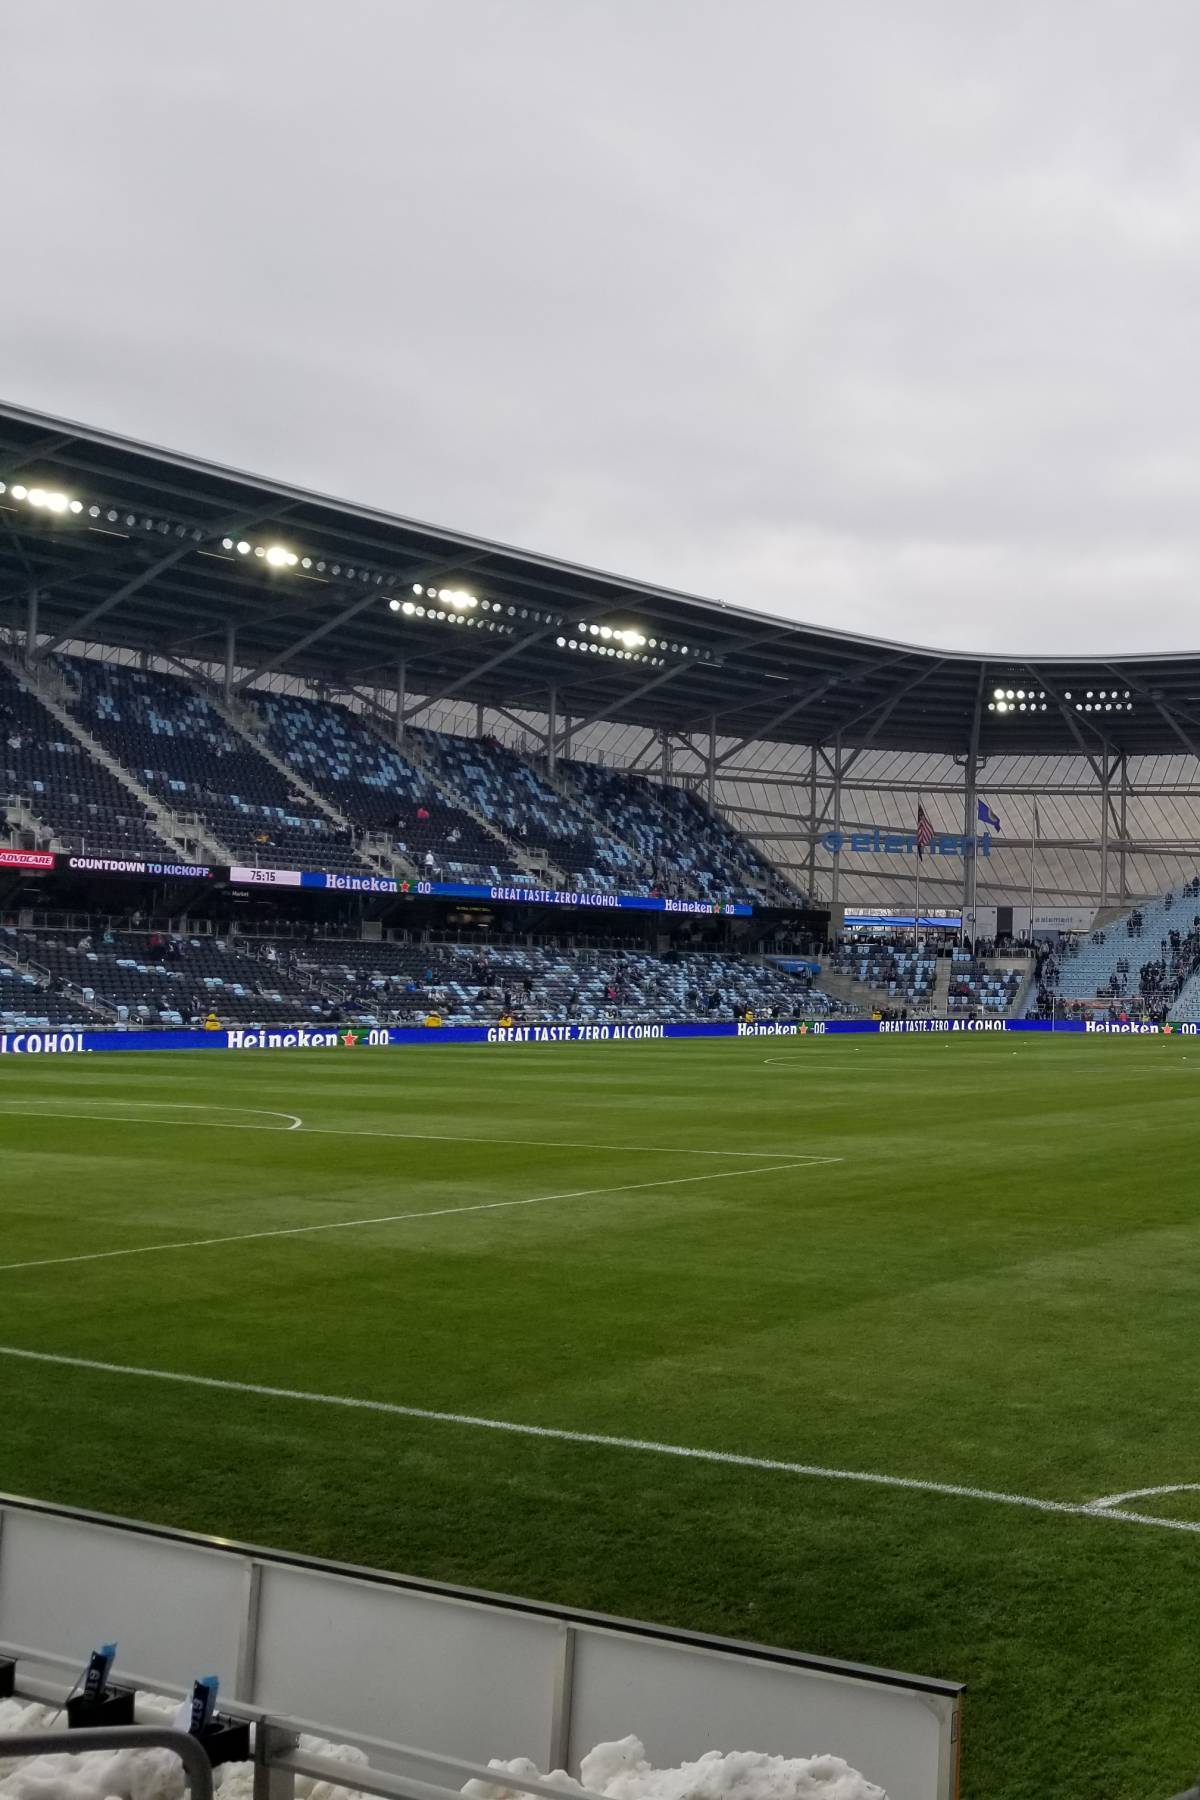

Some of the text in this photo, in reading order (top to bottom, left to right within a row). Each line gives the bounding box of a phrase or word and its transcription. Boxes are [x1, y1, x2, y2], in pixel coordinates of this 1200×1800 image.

[69, 857, 146, 873] COUNTDOWN
[146, 863, 162, 874] TO
[250, 870, 276, 882] 75:15
[325, 874, 398, 892] Heineken
[490, 887, 622, 907] GREAT TASTE. ZERO ALCOHOL.
[665, 900, 713, 914] Heineken
[487, 1025, 669, 1042] GREAT TASTE. ZERO ALCOHOL.
[737, 1022, 797, 1036] Heineken
[879, 1020, 1011, 1032] GREAT TASTE. ZERO ALCOHOL.
[1085, 1021, 1159, 1034] Heineken
[226, 1030, 338, 1049] Heineken
